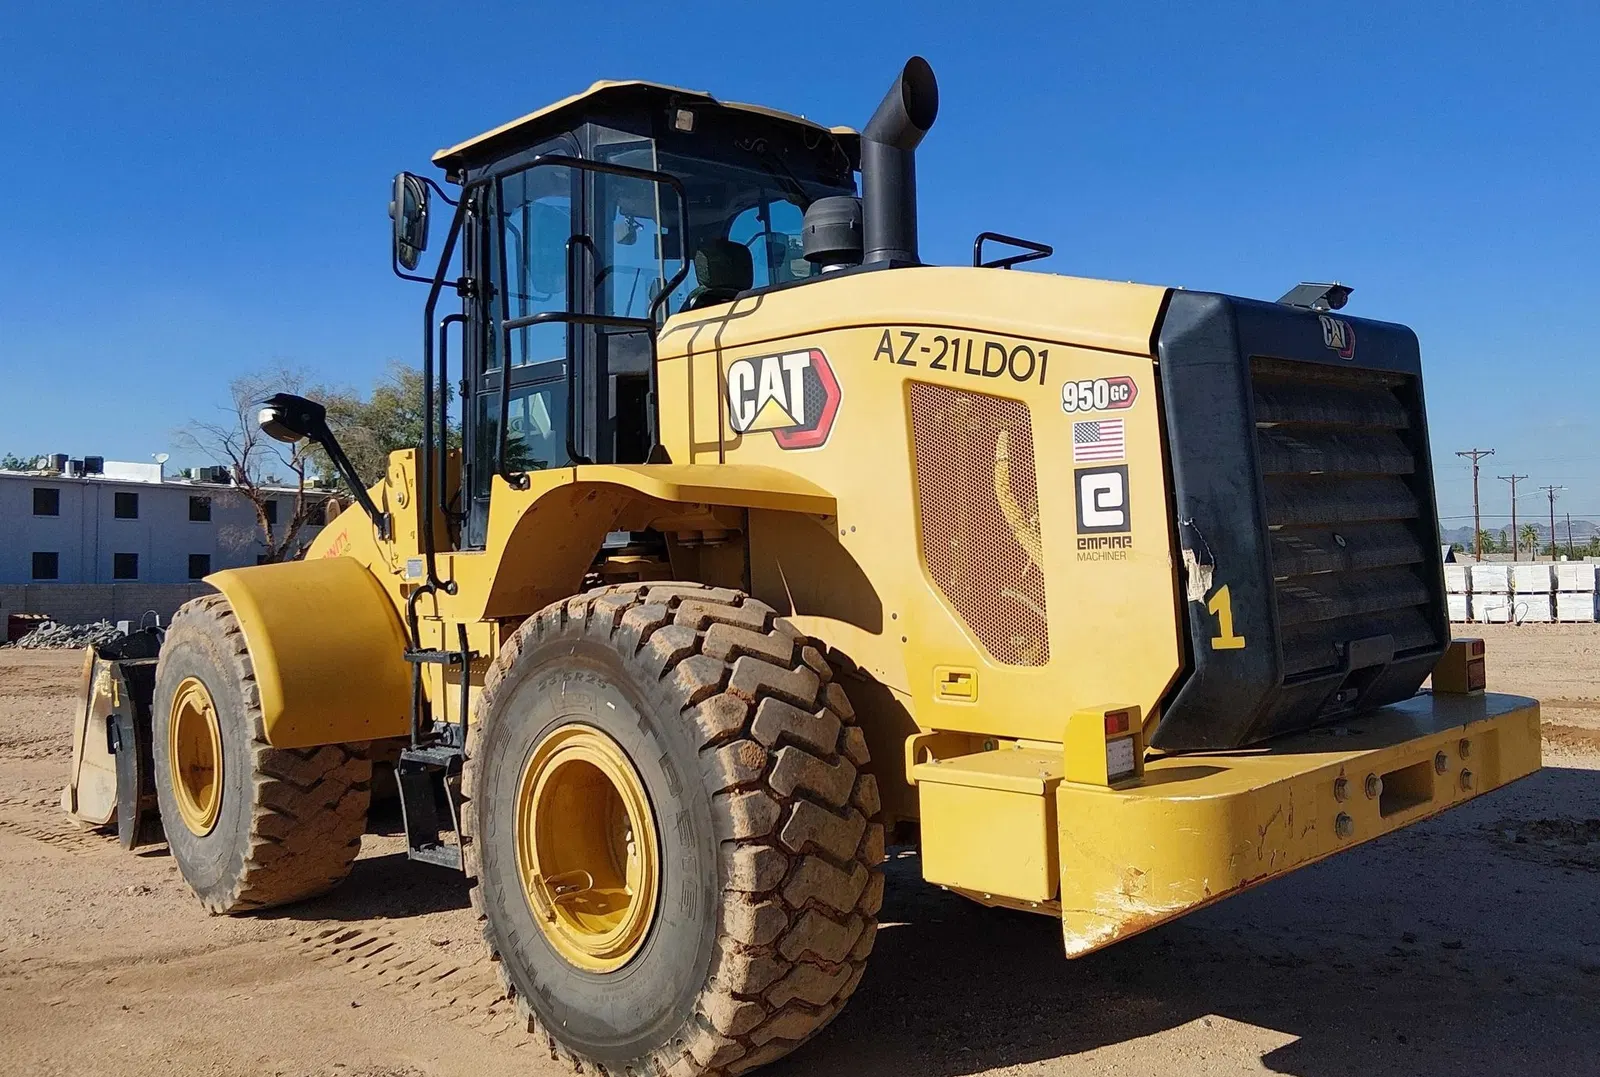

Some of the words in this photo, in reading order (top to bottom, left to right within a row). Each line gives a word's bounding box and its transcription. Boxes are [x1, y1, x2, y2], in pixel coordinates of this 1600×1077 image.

[1320, 316, 1346, 348] CAT
[728, 351, 810, 432] CAT
[1208, 584, 1246, 650] 1
